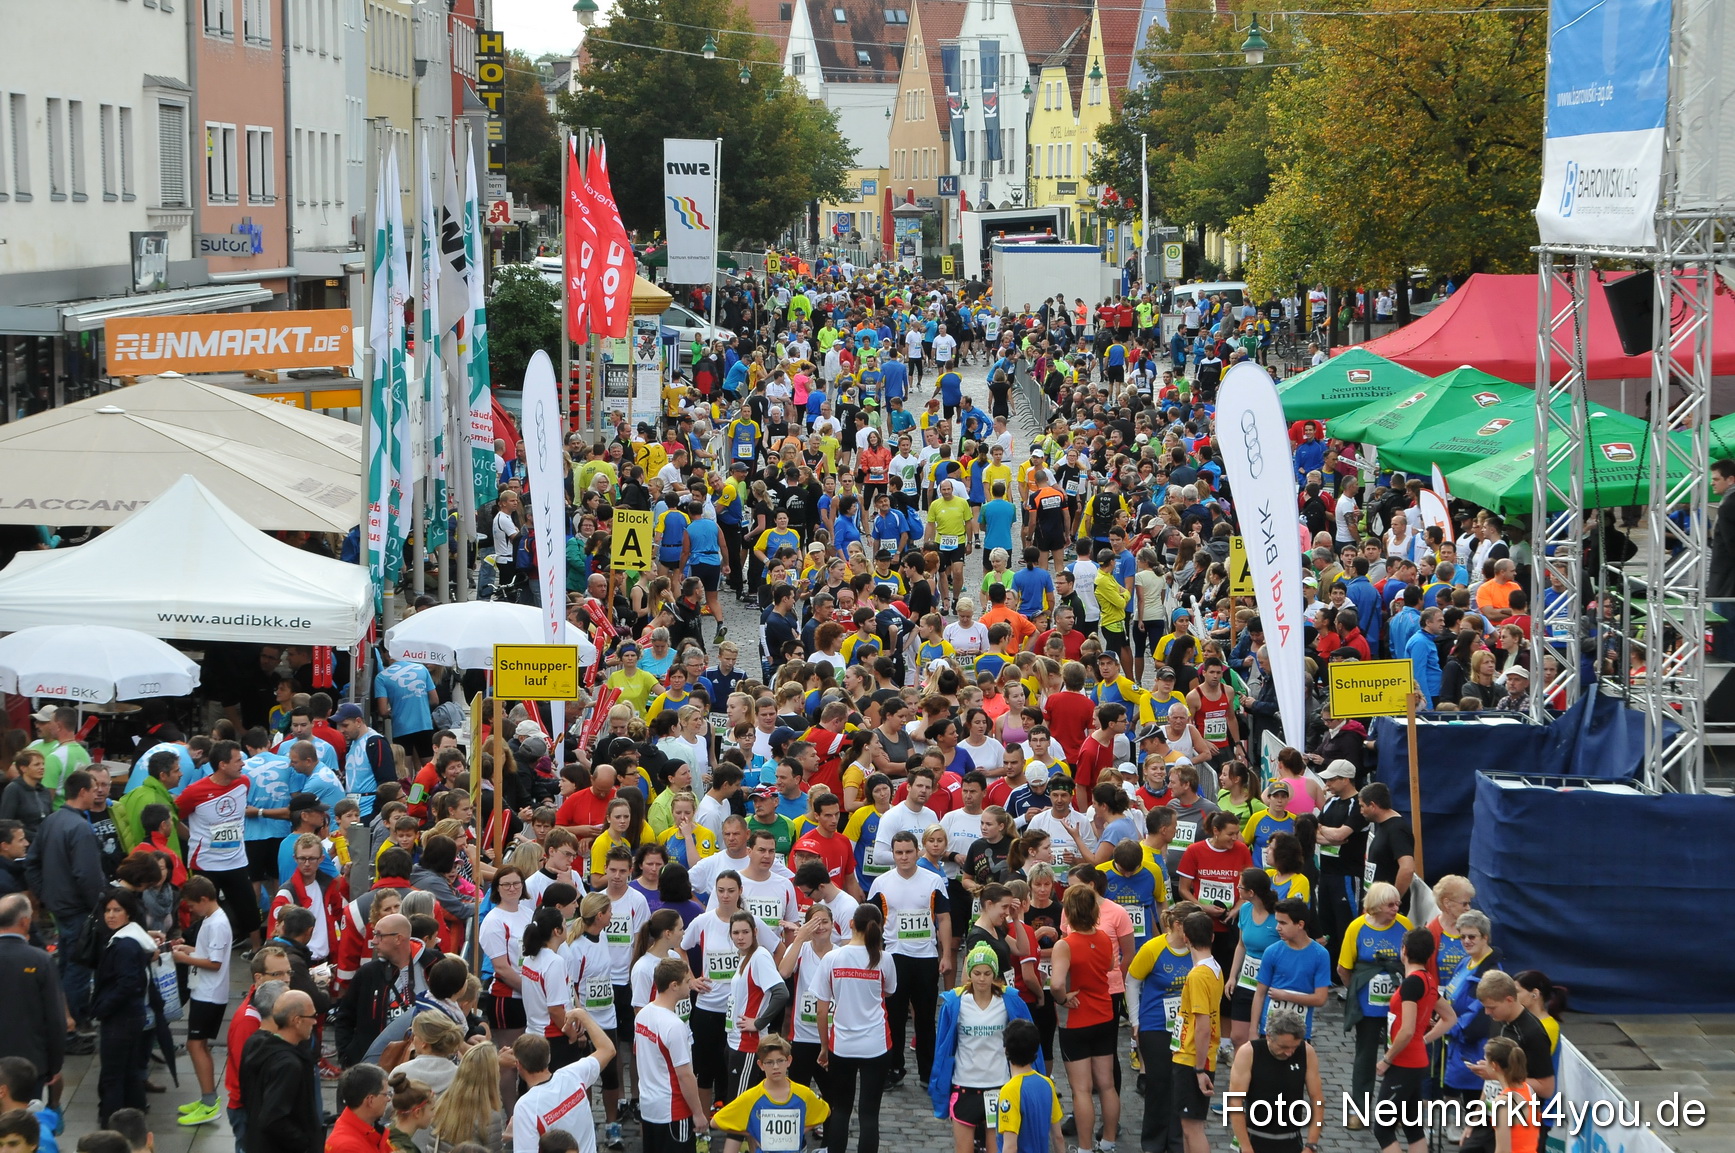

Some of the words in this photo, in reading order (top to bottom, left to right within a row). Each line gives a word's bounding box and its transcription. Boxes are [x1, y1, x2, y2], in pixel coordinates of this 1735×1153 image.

[1556, 80, 1614, 107] www.barowski-ag.de
[479, 34, 503, 169] HOTEL
[1577, 168, 1624, 198] BAROWSKI
[1624, 168, 1638, 198] AG
[770, 260, 777, 269] D
[945, 261, 952, 271] D
[1321, 390, 1397, 400] Lammsbrä
[1332, 385, 1391, 393] Neumarkter
[1448, 435, 1502, 446] Neumarkter
[617, 512, 648, 525] Block
[619, 528, 642, 557] A
[157, 612, 312, 629] www.audibkk.de
[403, 650, 427, 660] Audi
[430, 651, 447, 662] BKK
[956, 656, 974, 666] 5201
[500, 659, 572, 674] Schnupper-
[524, 675, 548, 687] lauf
[1335, 678, 1407, 691] Schnupper-
[35, 684, 67, 695] Audi
[72, 687, 99, 699] BKK
[1360, 691, 1383, 703] lauf
[711, 717, 727, 728] 552
[1207, 724, 1226, 734] 5179
[214, 830, 240, 842] 2901
[1176, 829, 1193, 841] 019
[974, 858, 987, 870] orld
[1198, 869, 1234, 877] NEUMARKT
[1203, 887, 1231, 901] 5046
[750, 904, 778, 916] 5191
[605, 921, 628, 934] 224
[900, 916, 929, 930] 5114
[709, 956, 739, 971] 5196
[836, 969, 880, 978] Bierschneider
[590, 983, 612, 998] 5205
[1373, 982, 1395, 994] 502
[676, 1001, 691, 1015] 185
[804, 1000, 835, 1014] 512
[547, 1090, 585, 1124] Bierschneider
[765, 1119, 798, 1134] 4001
